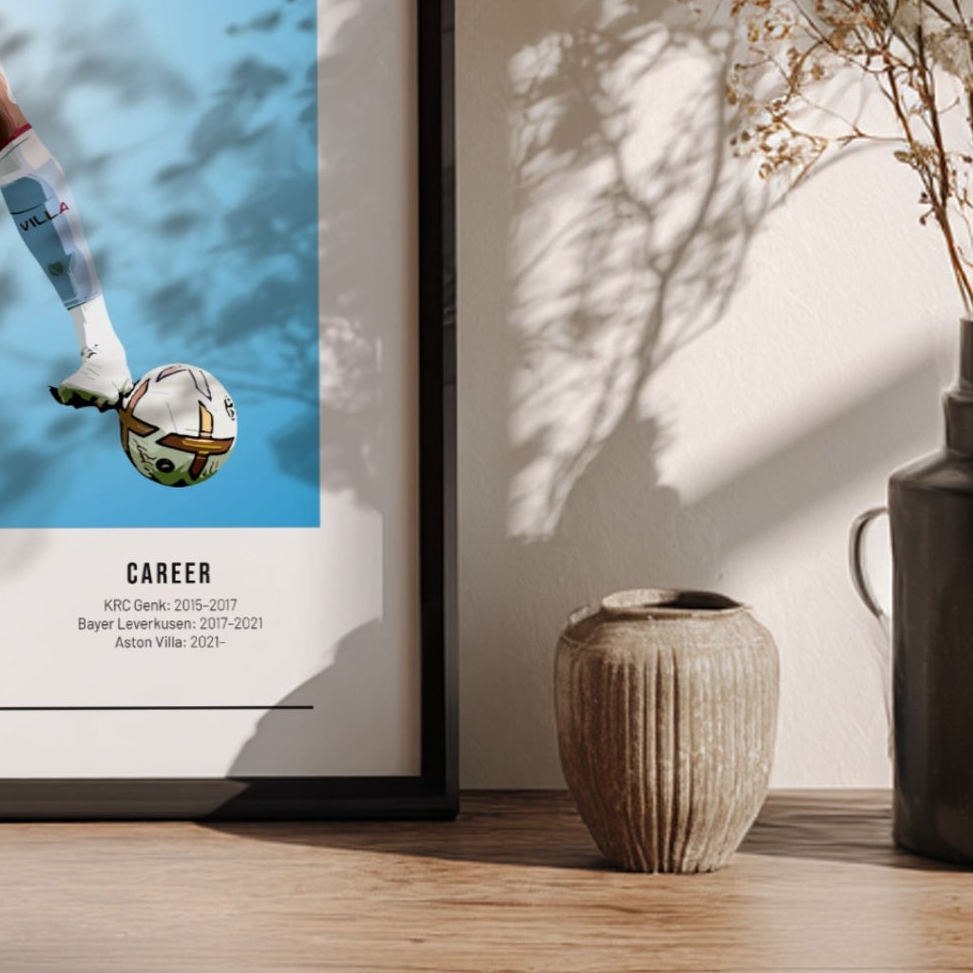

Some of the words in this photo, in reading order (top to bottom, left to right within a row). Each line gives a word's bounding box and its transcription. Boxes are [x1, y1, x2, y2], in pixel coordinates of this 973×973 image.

[20, 201, 69, 231] VILLA
[126, 562, 211, 584] CAREER
[104, 598, 131, 612] KRC
[133, 598, 171, 612] Genk:
[174, 598, 238, 612] 2015-2017
[78, 616, 115, 633] Bayer
[117, 616, 197, 630] Leverkusen:
[200, 616, 263, 630] 2017-2021
[114, 635, 153, 649] Aston
[155, 635, 187, 649] Villa:
[190, 635, 227, 649] 2021-
